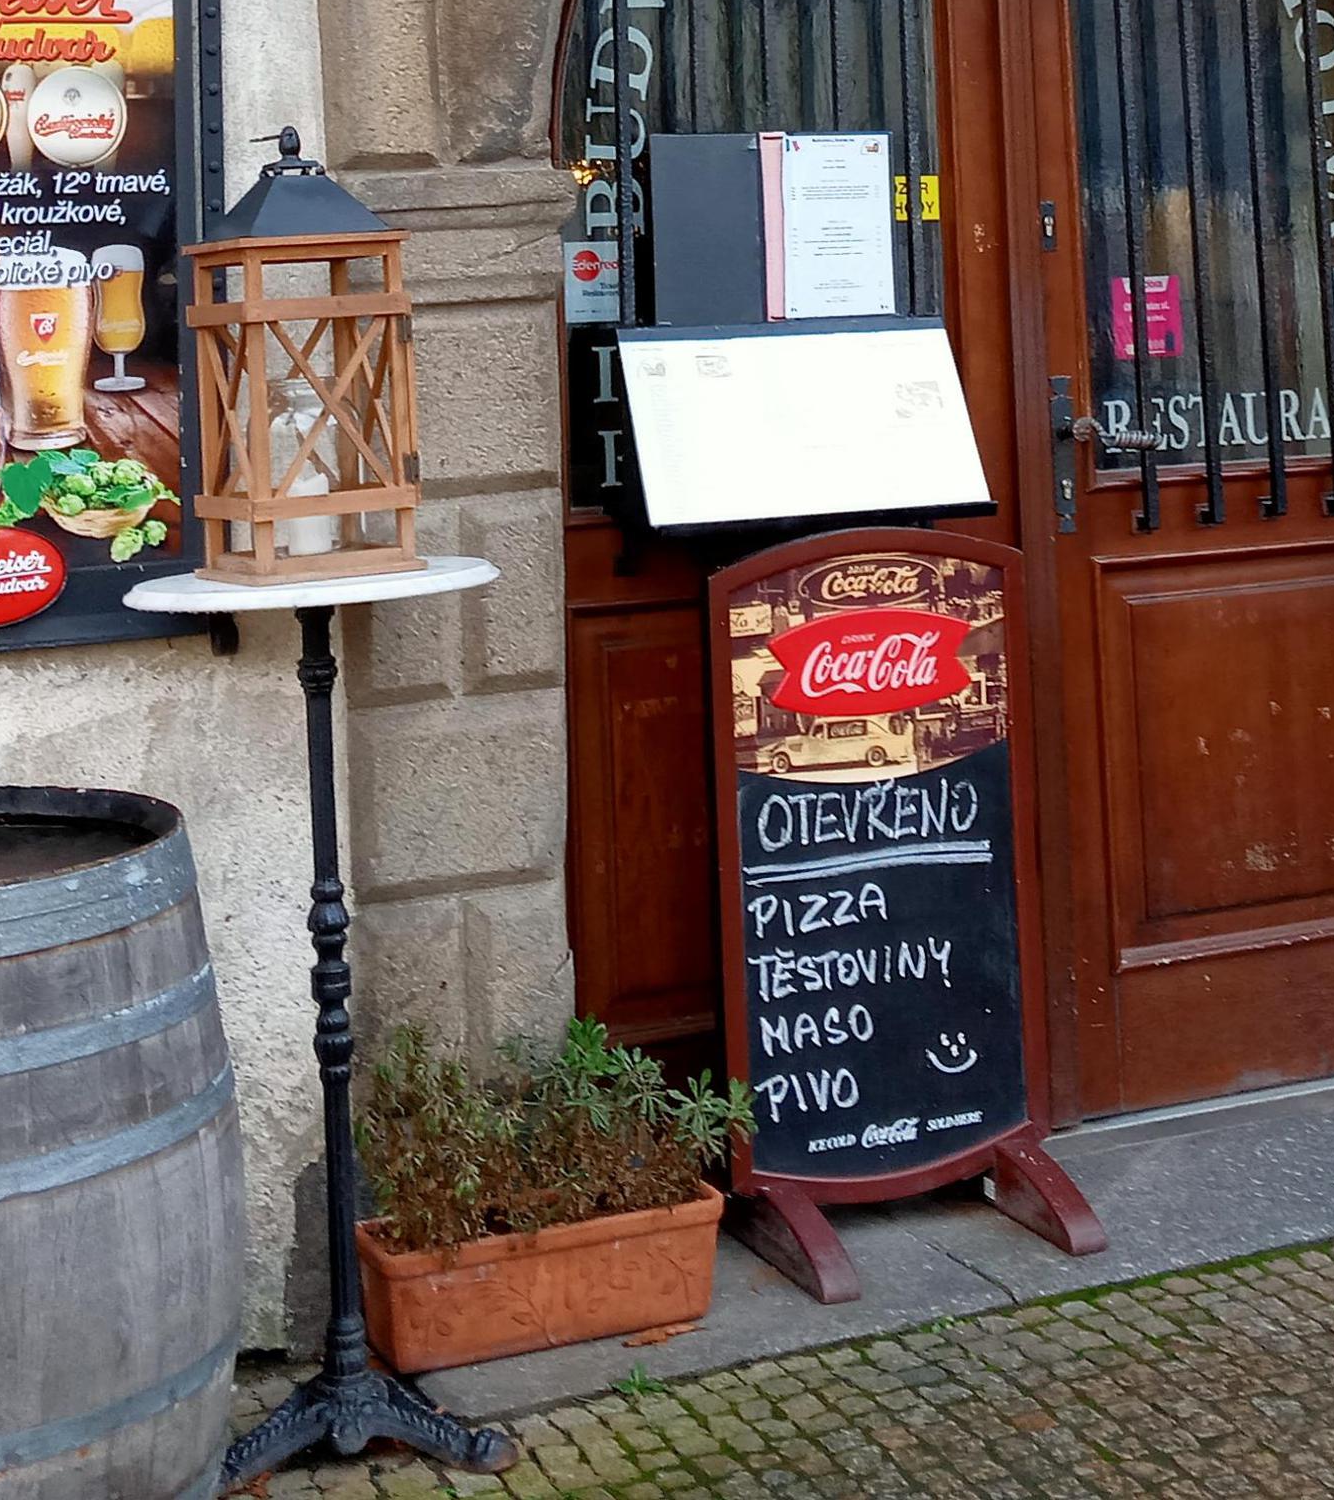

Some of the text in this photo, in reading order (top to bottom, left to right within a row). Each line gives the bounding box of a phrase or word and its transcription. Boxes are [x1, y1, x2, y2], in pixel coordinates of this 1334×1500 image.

[95, 169, 171, 195] tmavé,
[1, 199, 126, 225] kroužkové,
[66, 262, 113, 288] pivo
[821, 566, 922, 599] Coca-Cola
[800, 630, 941, 698] Coca-Cola
[757, 777, 980, 853] OTEVŘENO
[747, 883, 889, 940] PIZZA
[747, 936, 953, 1002] TĚSTOVINY
[760, 1004, 875, 1057] MASO
[754, 1068, 860, 1124] PIVO
